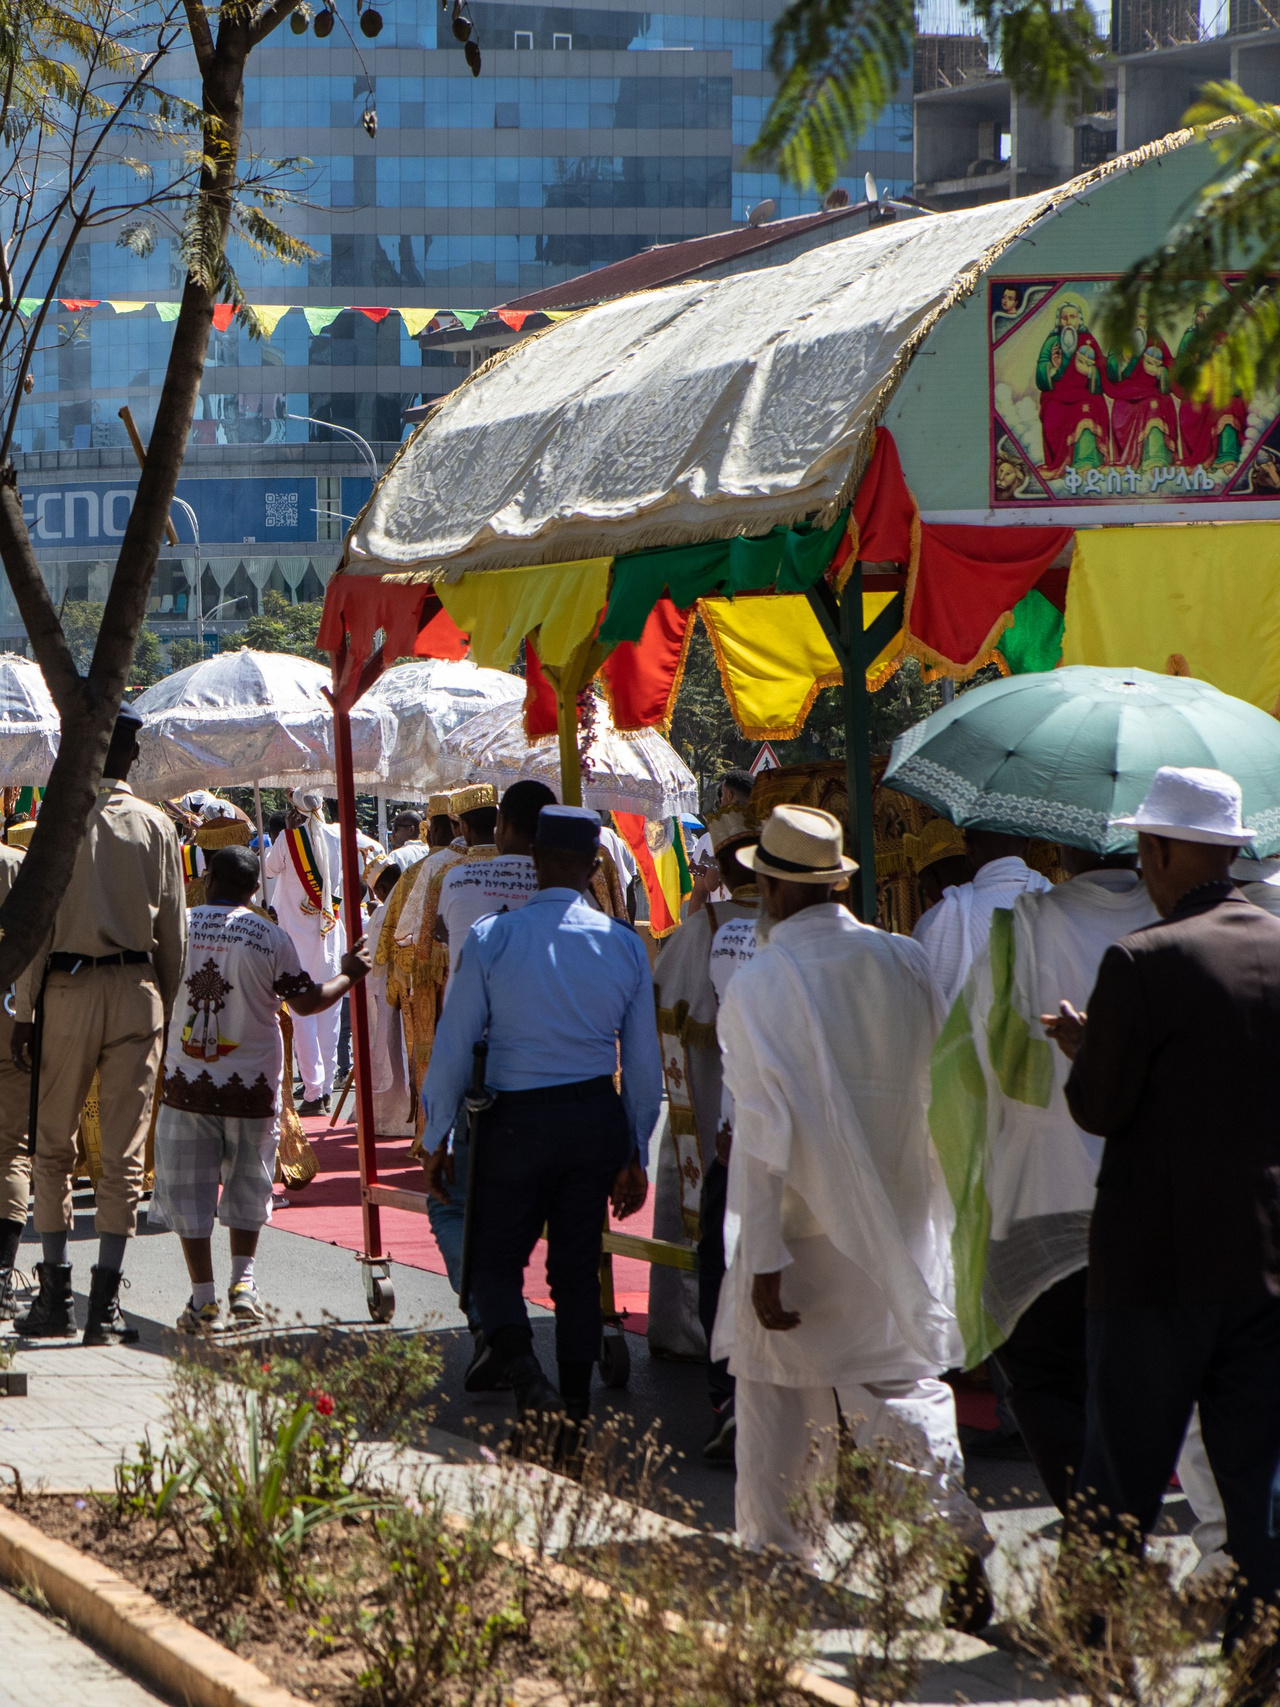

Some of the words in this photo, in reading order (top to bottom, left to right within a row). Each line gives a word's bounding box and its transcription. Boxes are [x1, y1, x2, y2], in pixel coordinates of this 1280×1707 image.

[1064, 464, 1142, 495] ቅድስት
[1150, 464, 1215, 493] ሥላሴ
[22, 489, 137, 540] ECNO
